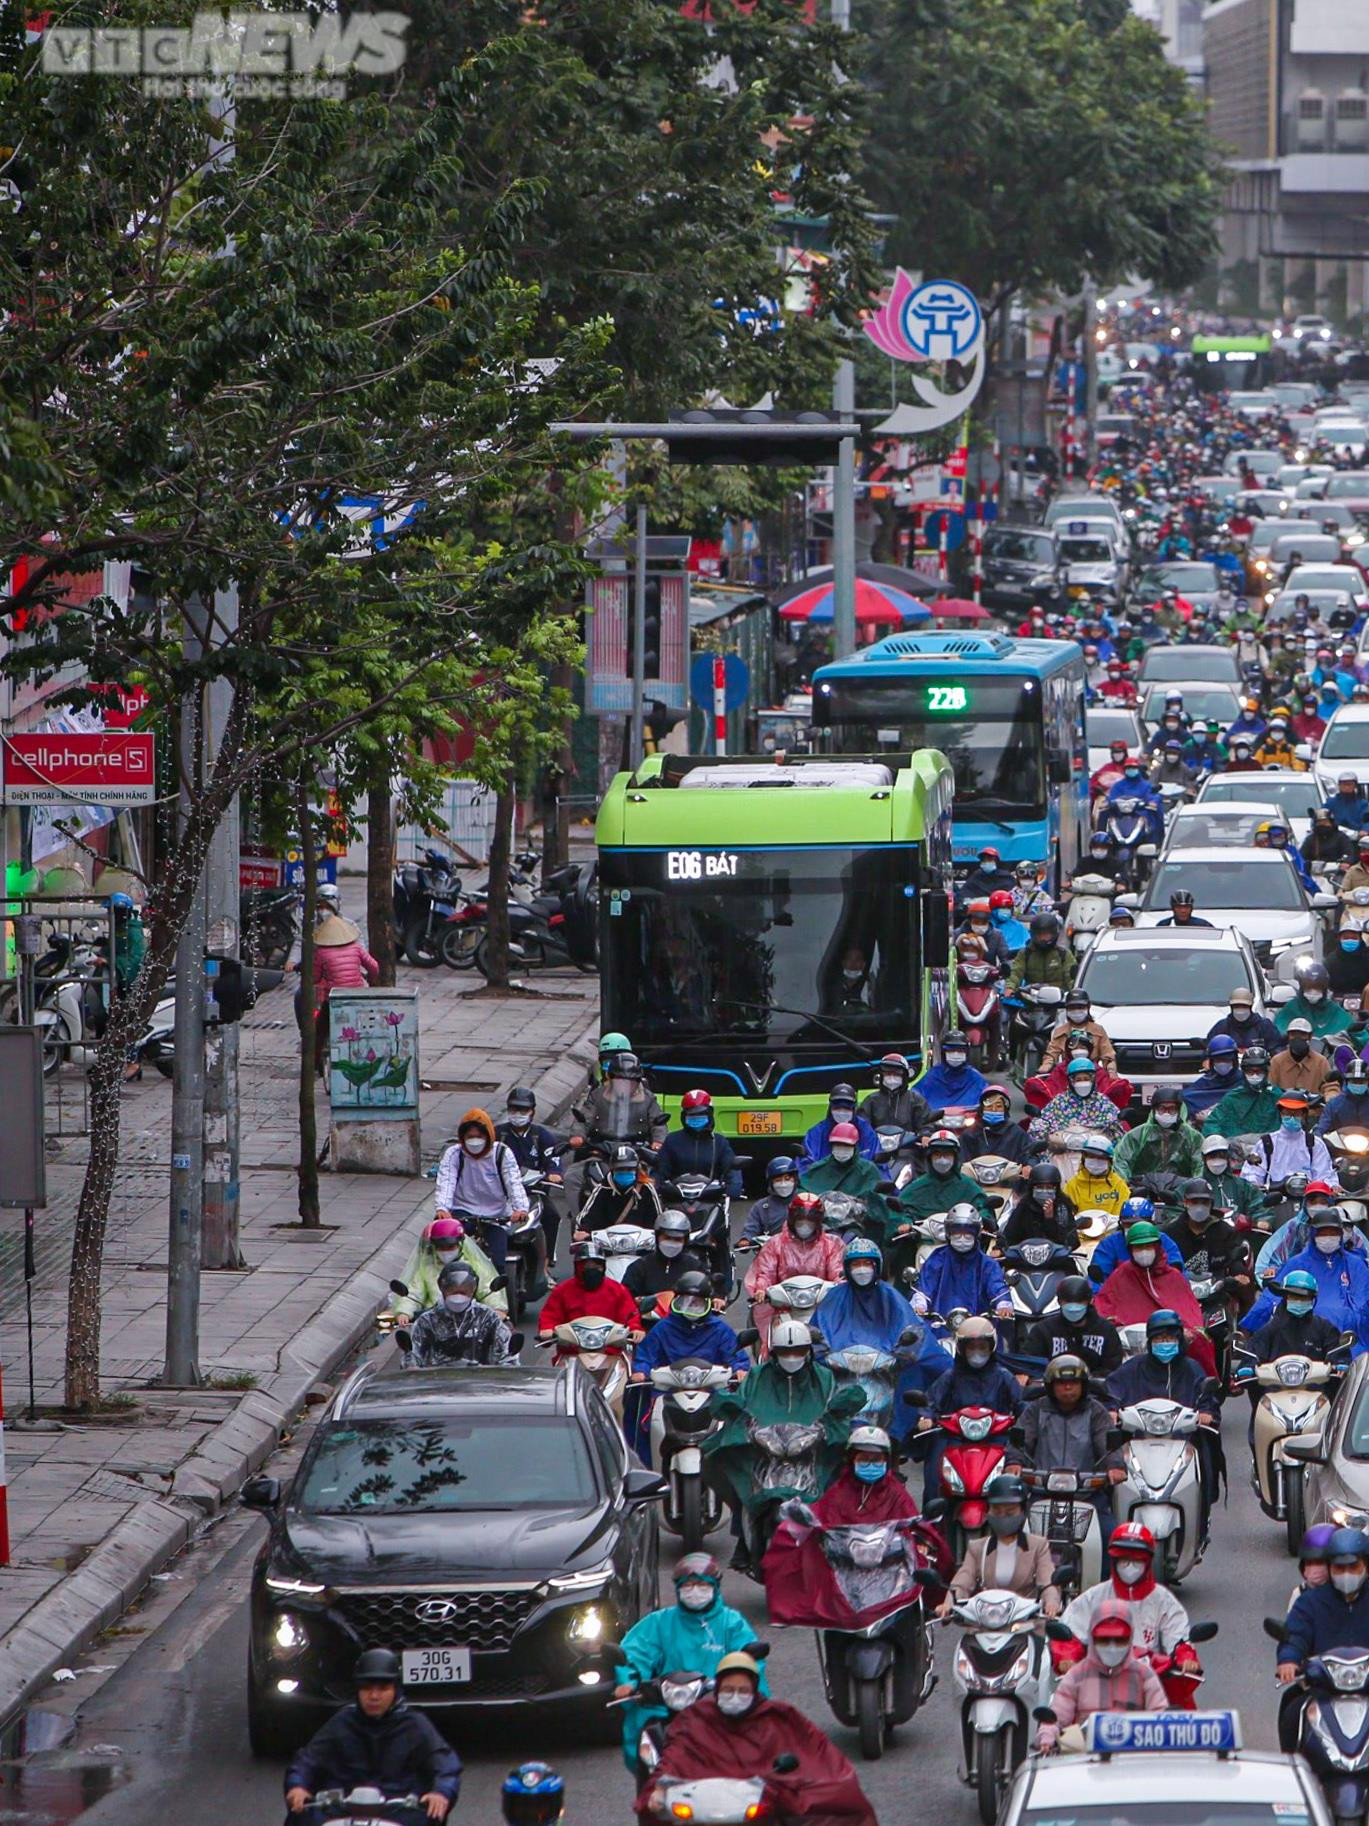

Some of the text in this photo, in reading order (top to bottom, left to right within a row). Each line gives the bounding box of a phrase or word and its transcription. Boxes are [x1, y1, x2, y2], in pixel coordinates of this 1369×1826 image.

[421, 1650, 451, 1666] 30G
[409, 1666, 462, 1682] 570.31
[1133, 1724, 1164, 1747] SAO
